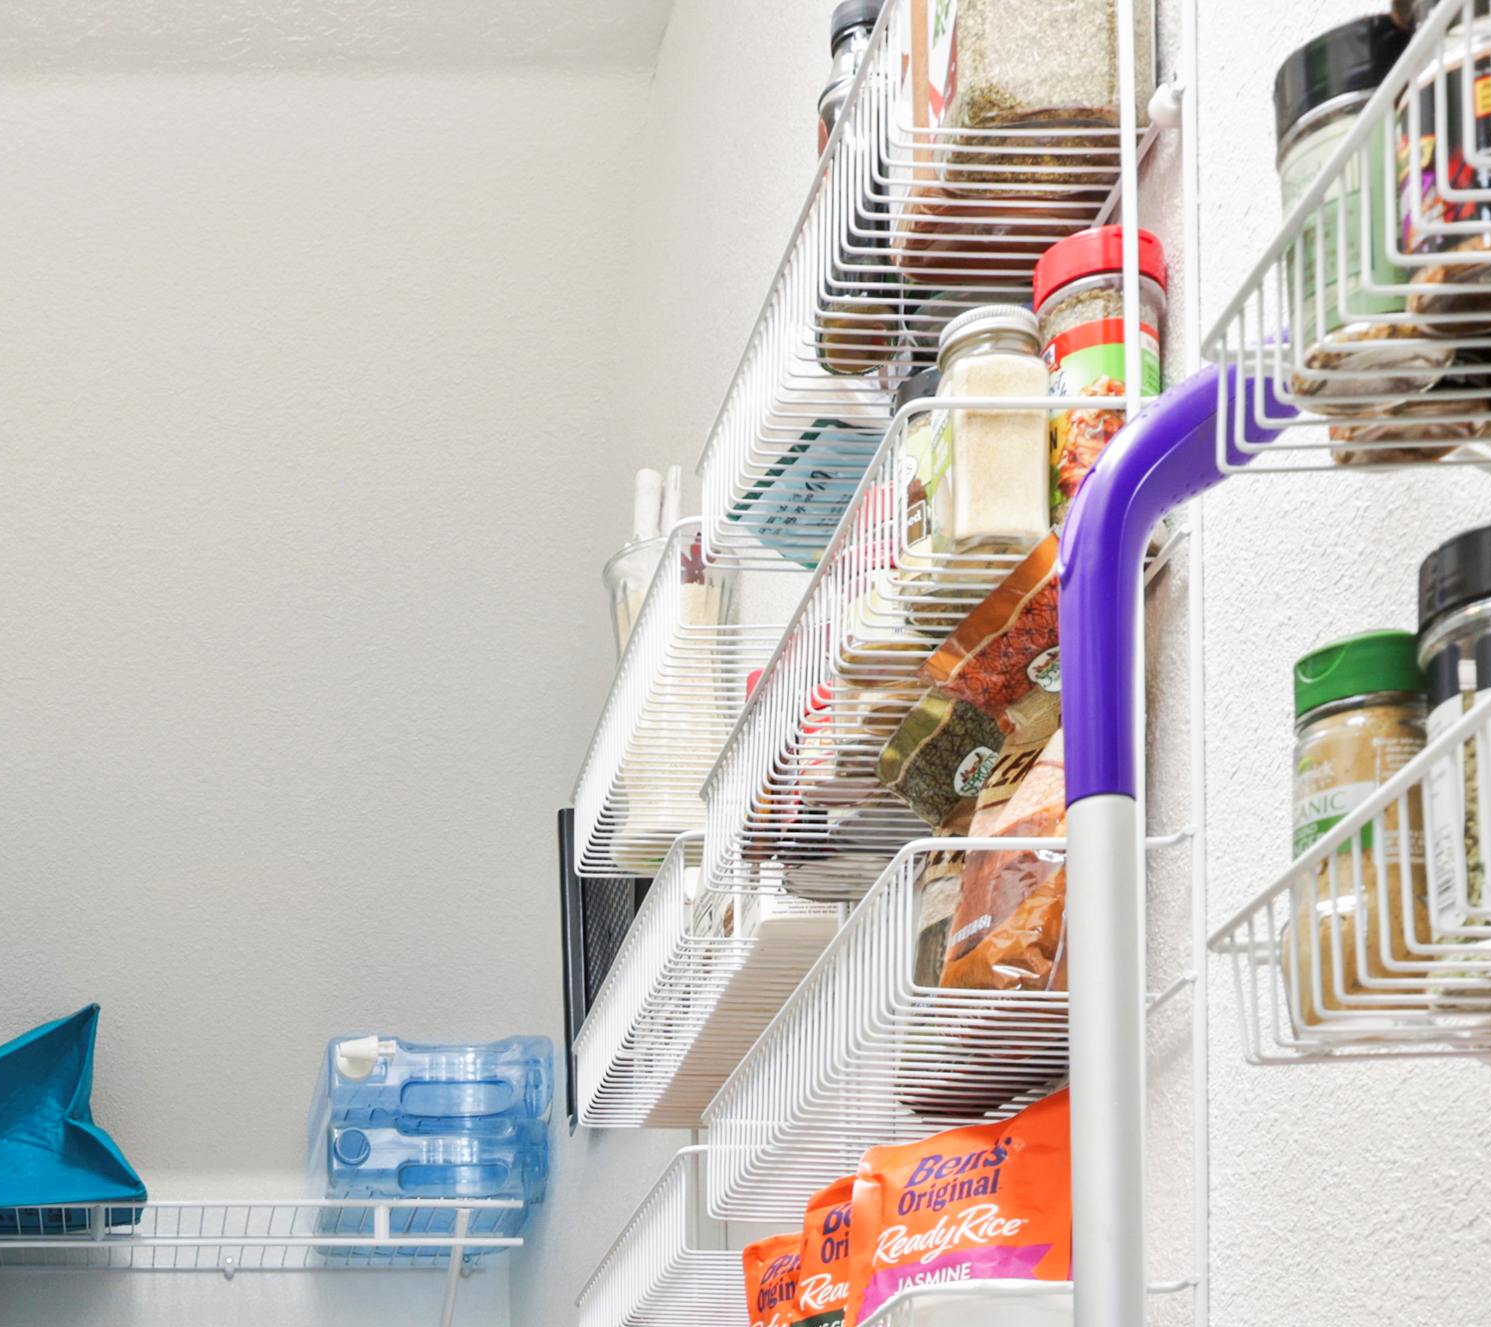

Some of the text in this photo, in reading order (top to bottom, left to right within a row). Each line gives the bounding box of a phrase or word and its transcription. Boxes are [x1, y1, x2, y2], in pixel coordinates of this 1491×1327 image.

[903, 1137, 1013, 1189] Ben's
[898, 1169, 1001, 1217] Original
[873, 1203, 1021, 1266] Ready Rice
